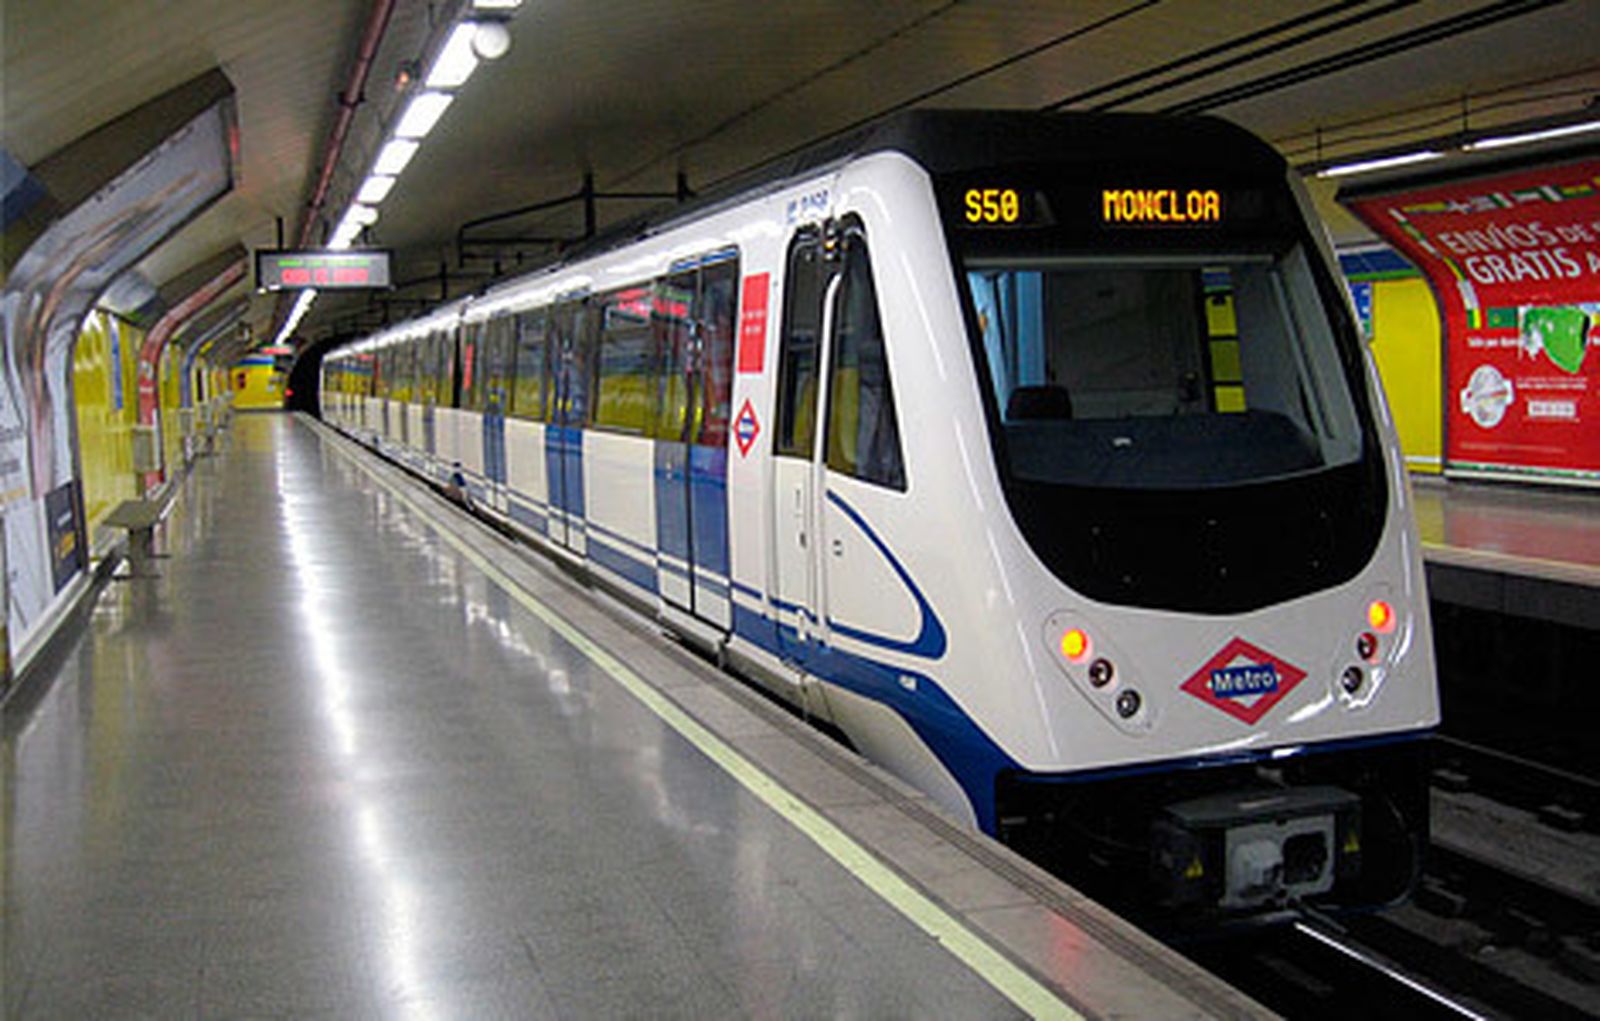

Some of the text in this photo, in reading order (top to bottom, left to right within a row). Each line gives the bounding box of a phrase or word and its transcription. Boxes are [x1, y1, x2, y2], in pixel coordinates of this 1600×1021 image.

[965, 189, 1220, 222] S50 MONCLOA
[1438, 222, 1558, 254] ENVÍOS
[1465, 247, 1582, 284] GRATIS
[1214, 670, 1273, 691] Metro
